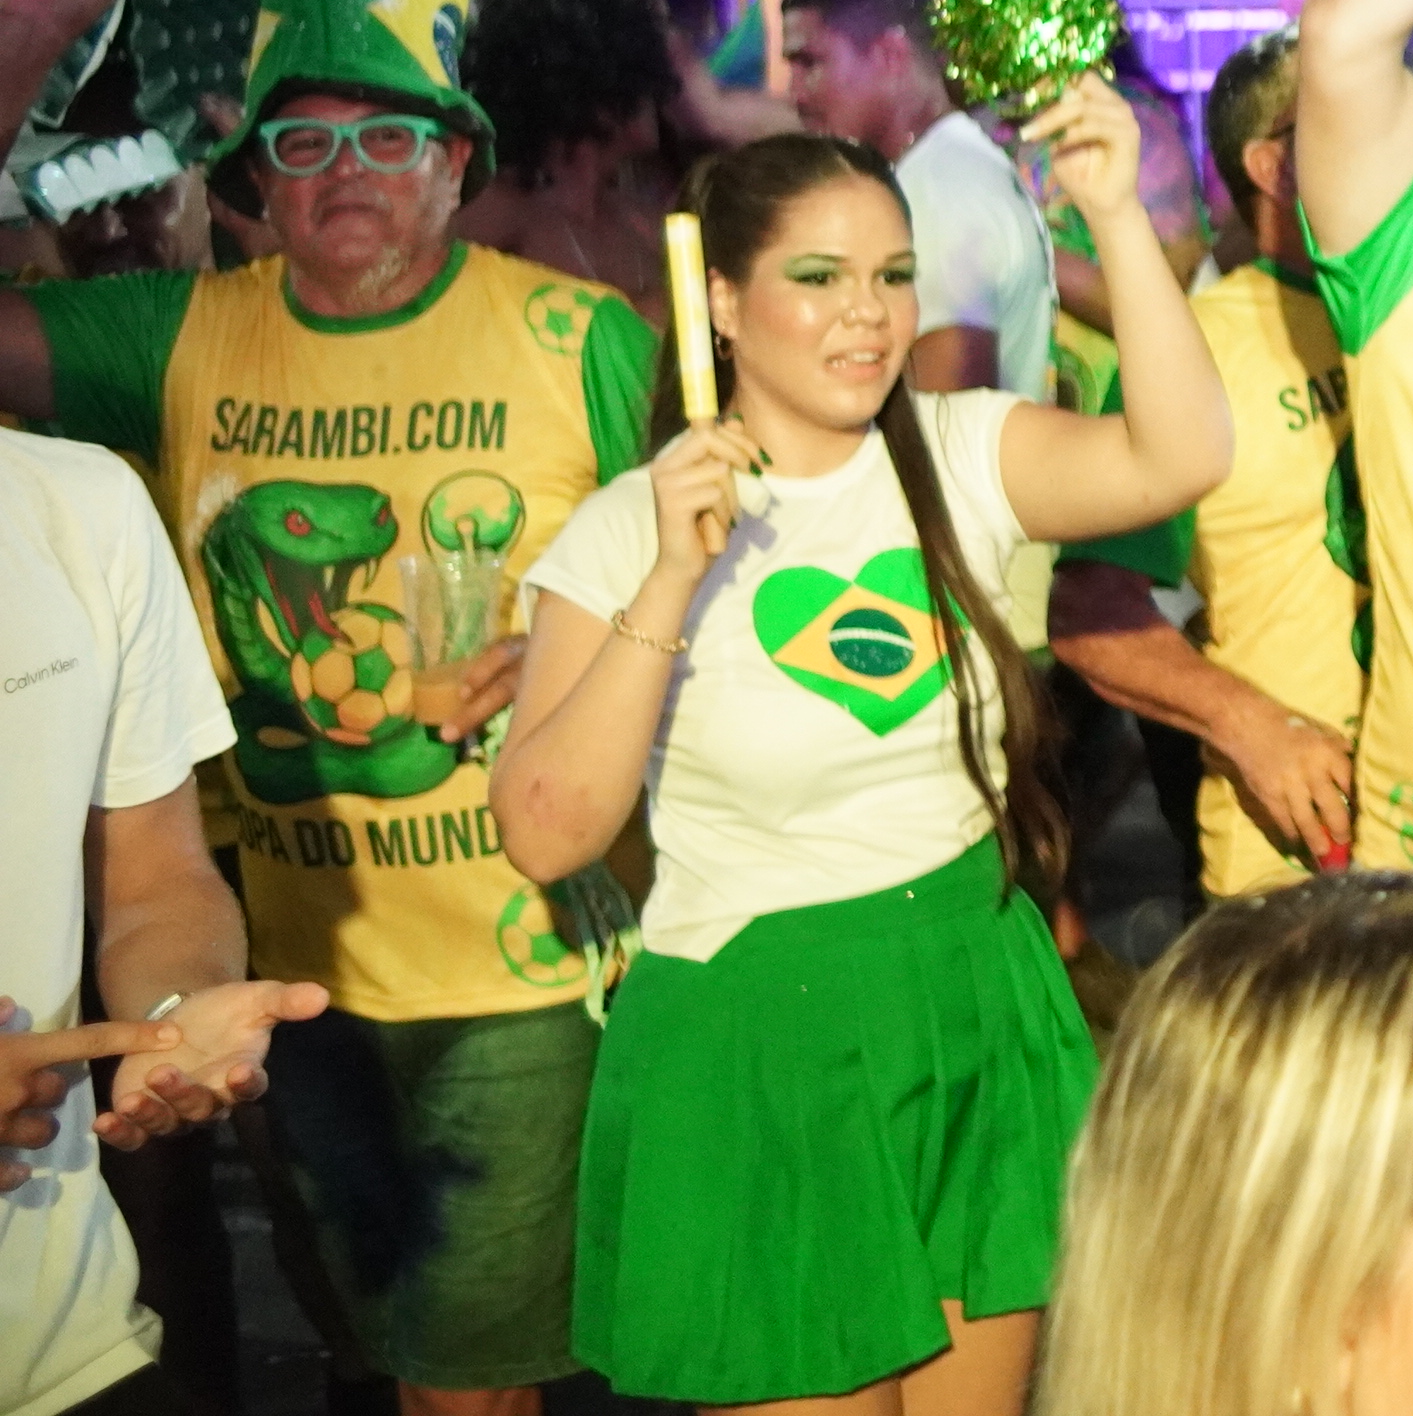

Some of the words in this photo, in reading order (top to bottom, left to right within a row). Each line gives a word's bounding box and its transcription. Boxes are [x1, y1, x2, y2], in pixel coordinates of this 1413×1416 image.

[210, 396, 507, 460] SARAMBI.COM
[4, 671, 50, 694] Calvin
[51, 656, 80, 676] Klein
[293, 817, 356, 868] DO
[366, 804, 501, 868] MUND
